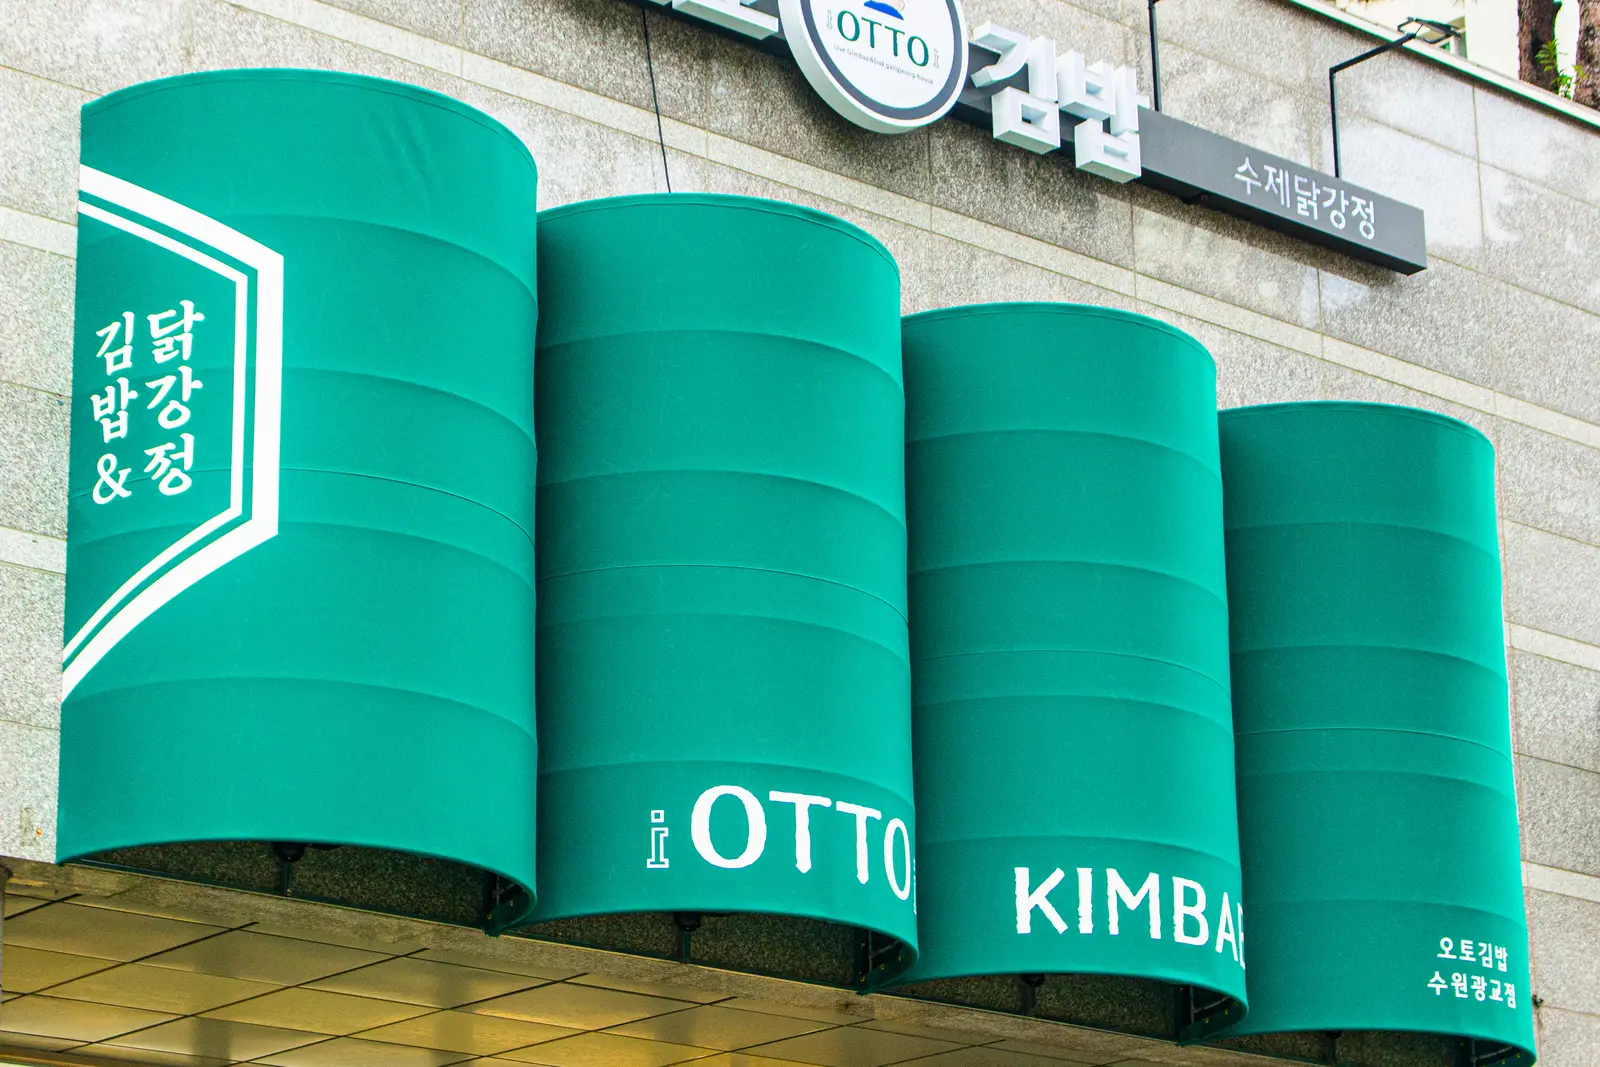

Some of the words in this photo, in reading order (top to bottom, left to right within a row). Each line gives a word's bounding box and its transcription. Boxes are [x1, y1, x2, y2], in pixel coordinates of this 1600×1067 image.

[837, 10, 929, 67] OTTO
[972, 22, 1152, 184] 김밥
[691, 785, 911, 901] OTTO
[1437, 937, 1508, 972] 오토김밥
[1427, 971, 1516, 1009] 수원광교점
